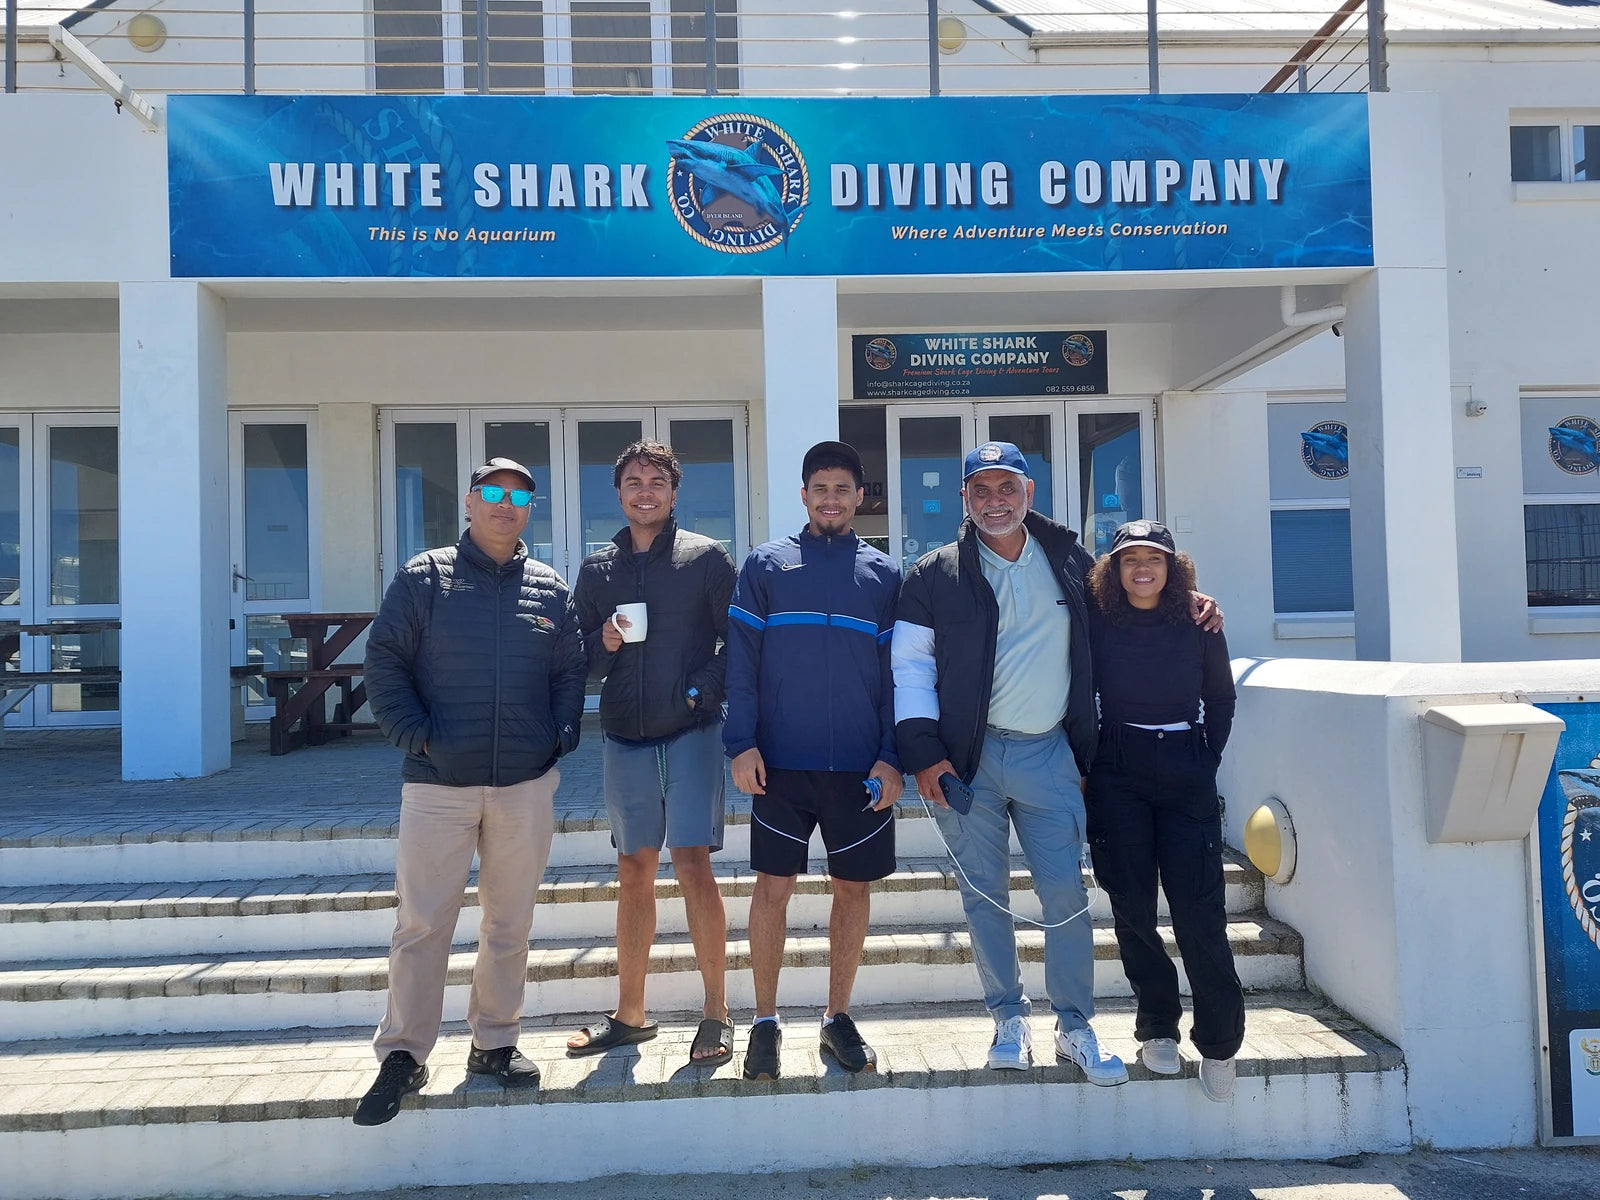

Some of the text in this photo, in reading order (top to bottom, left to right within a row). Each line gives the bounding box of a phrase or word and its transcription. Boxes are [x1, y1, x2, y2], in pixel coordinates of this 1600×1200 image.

[269, 162, 649, 208] WHITE SHARK
[677, 122, 801, 246] WHITE SHARK DIVING CO.
[831, 158, 1285, 206] DIVING COMPANY
[368, 227, 556, 245] This is No Aquarium
[891, 220, 1228, 240] Where Adventure Meets Conservation
[924, 336, 1038, 350] WHITE SHARK
[910, 354, 966, 366] DIVING
[970, 352, 1050, 365] COMPANY
[934, 368, 956, 376] Shark
[958, 368, 972, 376] Cage
[975, 367, 996, 376] Diving
[1042, 366, 1060, 374] Tours
[866, 380, 971, 388] info@sharkcagediving.co.za
[866, 388, 970, 396] www.sharkcagediving.co.za
